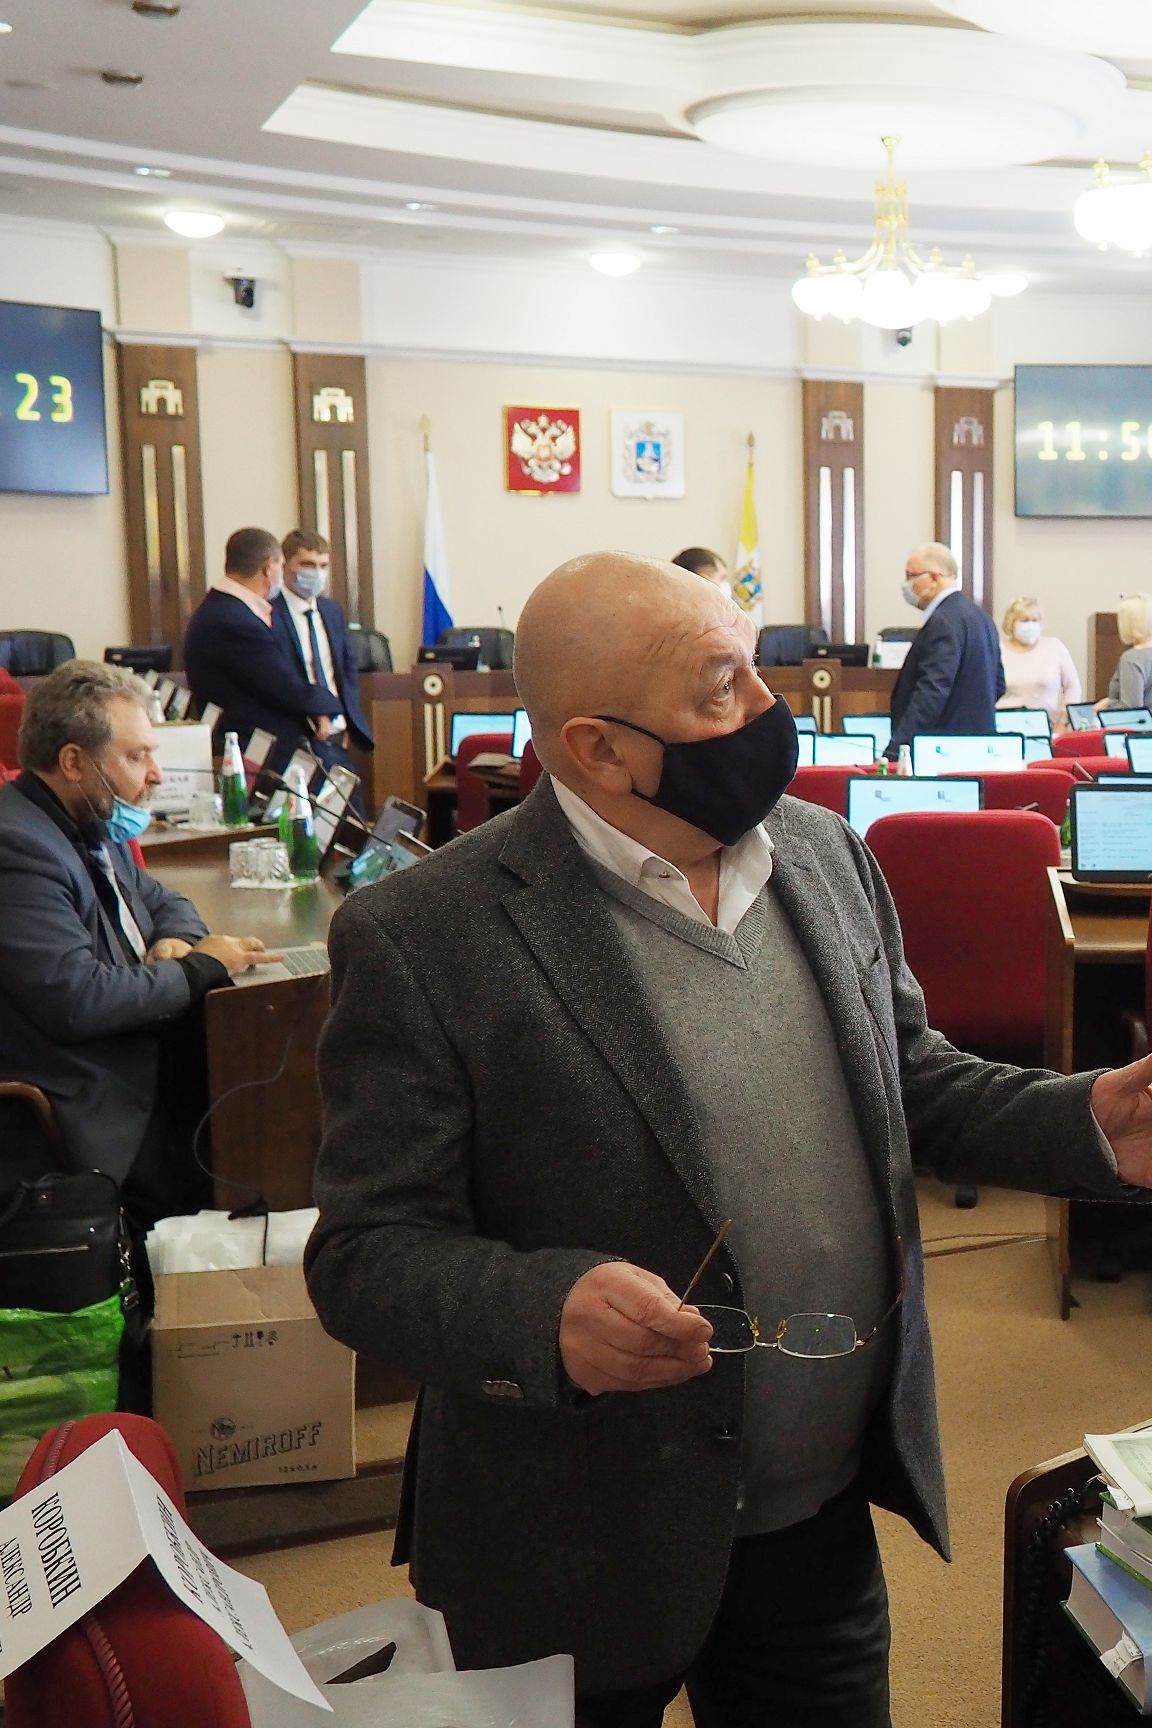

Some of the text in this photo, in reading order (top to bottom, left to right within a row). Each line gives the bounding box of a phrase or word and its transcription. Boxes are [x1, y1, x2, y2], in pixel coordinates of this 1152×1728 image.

[192, 1421, 322, 1477] NEMIROFF
[0, 1537, 33, 1619] АЛЕКСАНДР
[31, 1491, 82, 1609] КОРОБКИН
